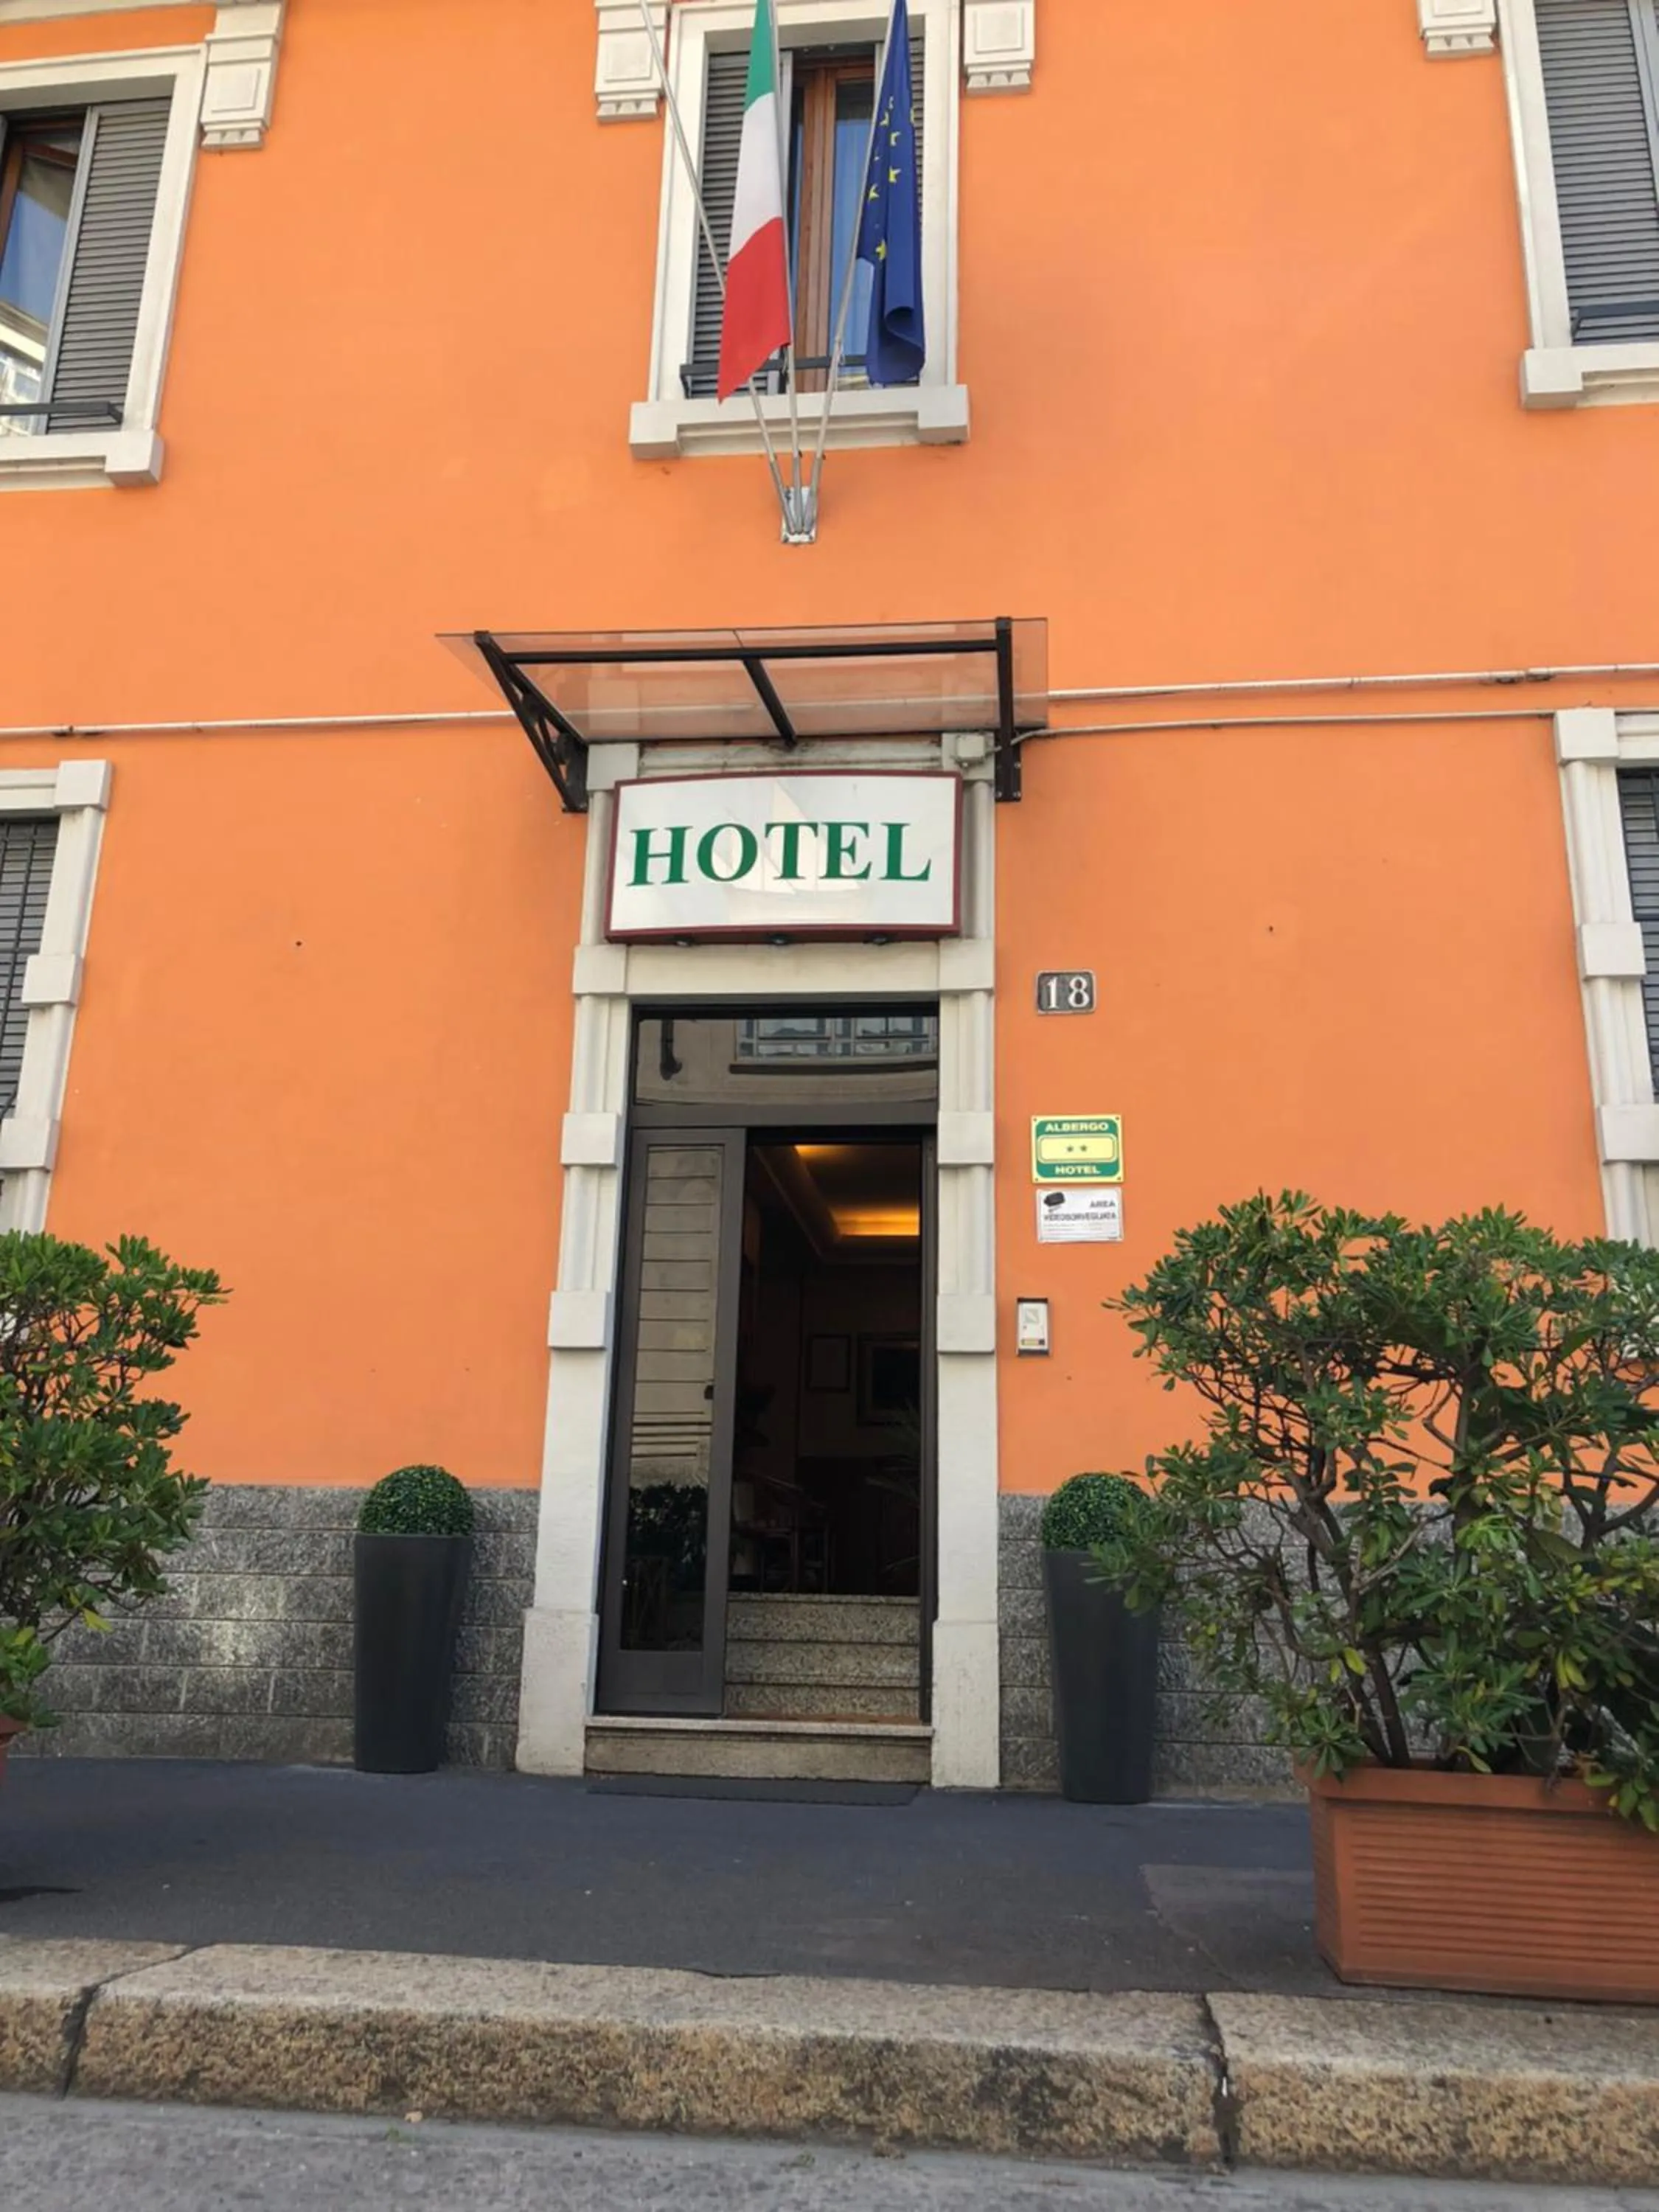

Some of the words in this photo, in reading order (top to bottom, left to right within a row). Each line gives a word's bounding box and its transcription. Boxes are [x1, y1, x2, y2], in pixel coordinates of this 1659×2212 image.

[626, 822, 932, 886] HOTEL
[1047, 975, 1091, 1009] 18
[1044, 1122, 1110, 1133] ALBERGO
[1054, 1165, 1102, 1175] HOTEL
[1090, 1200, 1116, 1208] AREA
